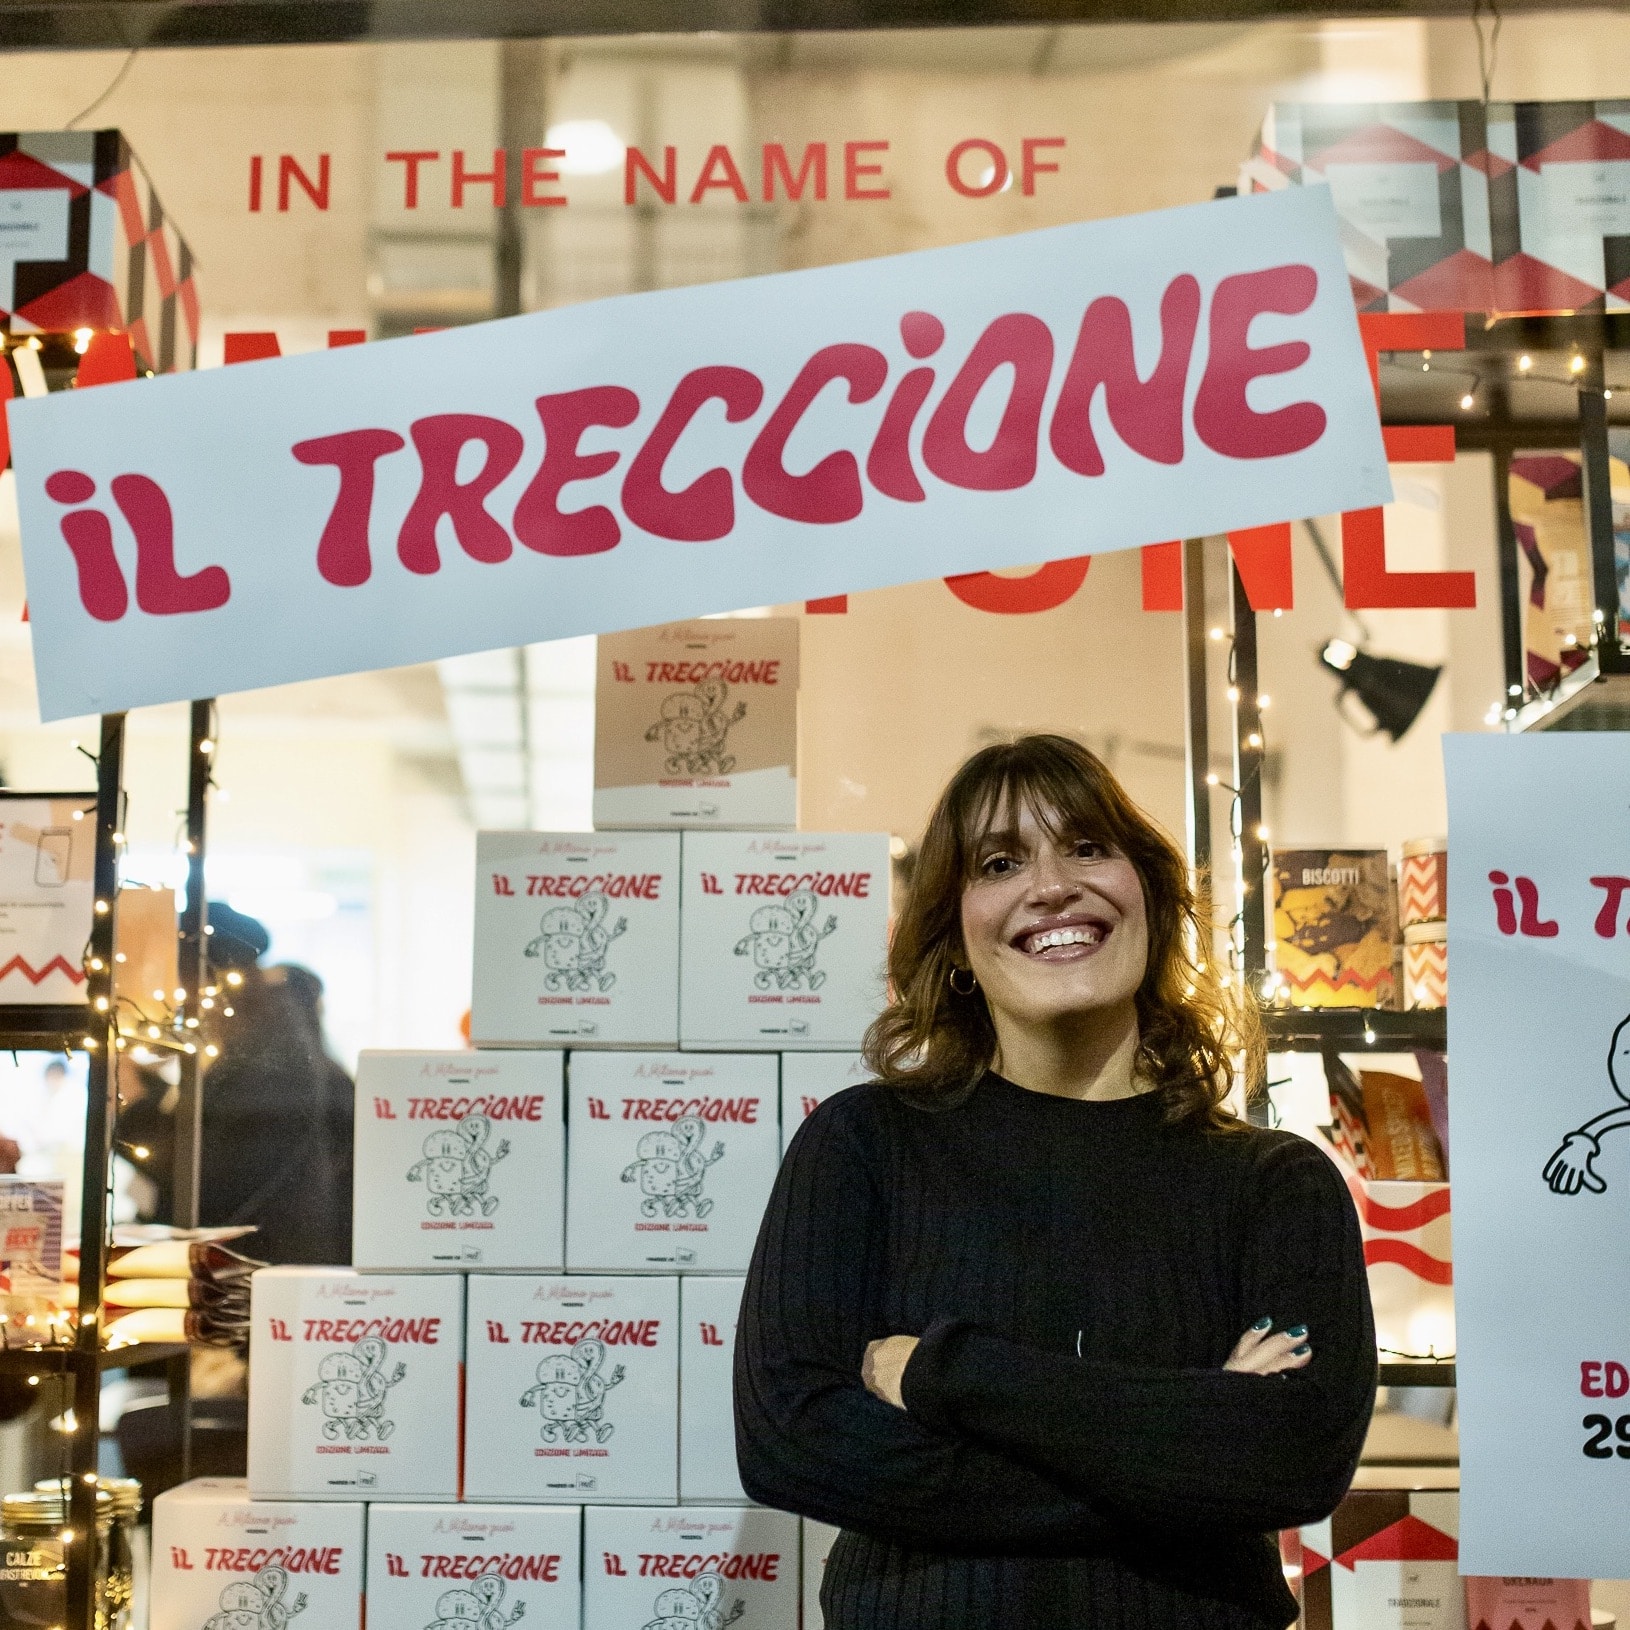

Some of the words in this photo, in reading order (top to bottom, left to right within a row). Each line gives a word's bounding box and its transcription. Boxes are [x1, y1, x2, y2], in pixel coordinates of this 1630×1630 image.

[248, 153, 331, 214] IN
[385, 148, 568, 210] THE
[624, 140, 890, 206] NAME
[944, 137, 1067, 199] OF
[1302, 868, 1359, 886] BISCOTTI
[1589, 876, 1630, 938] T
[1580, 1361, 1630, 1398] ED
